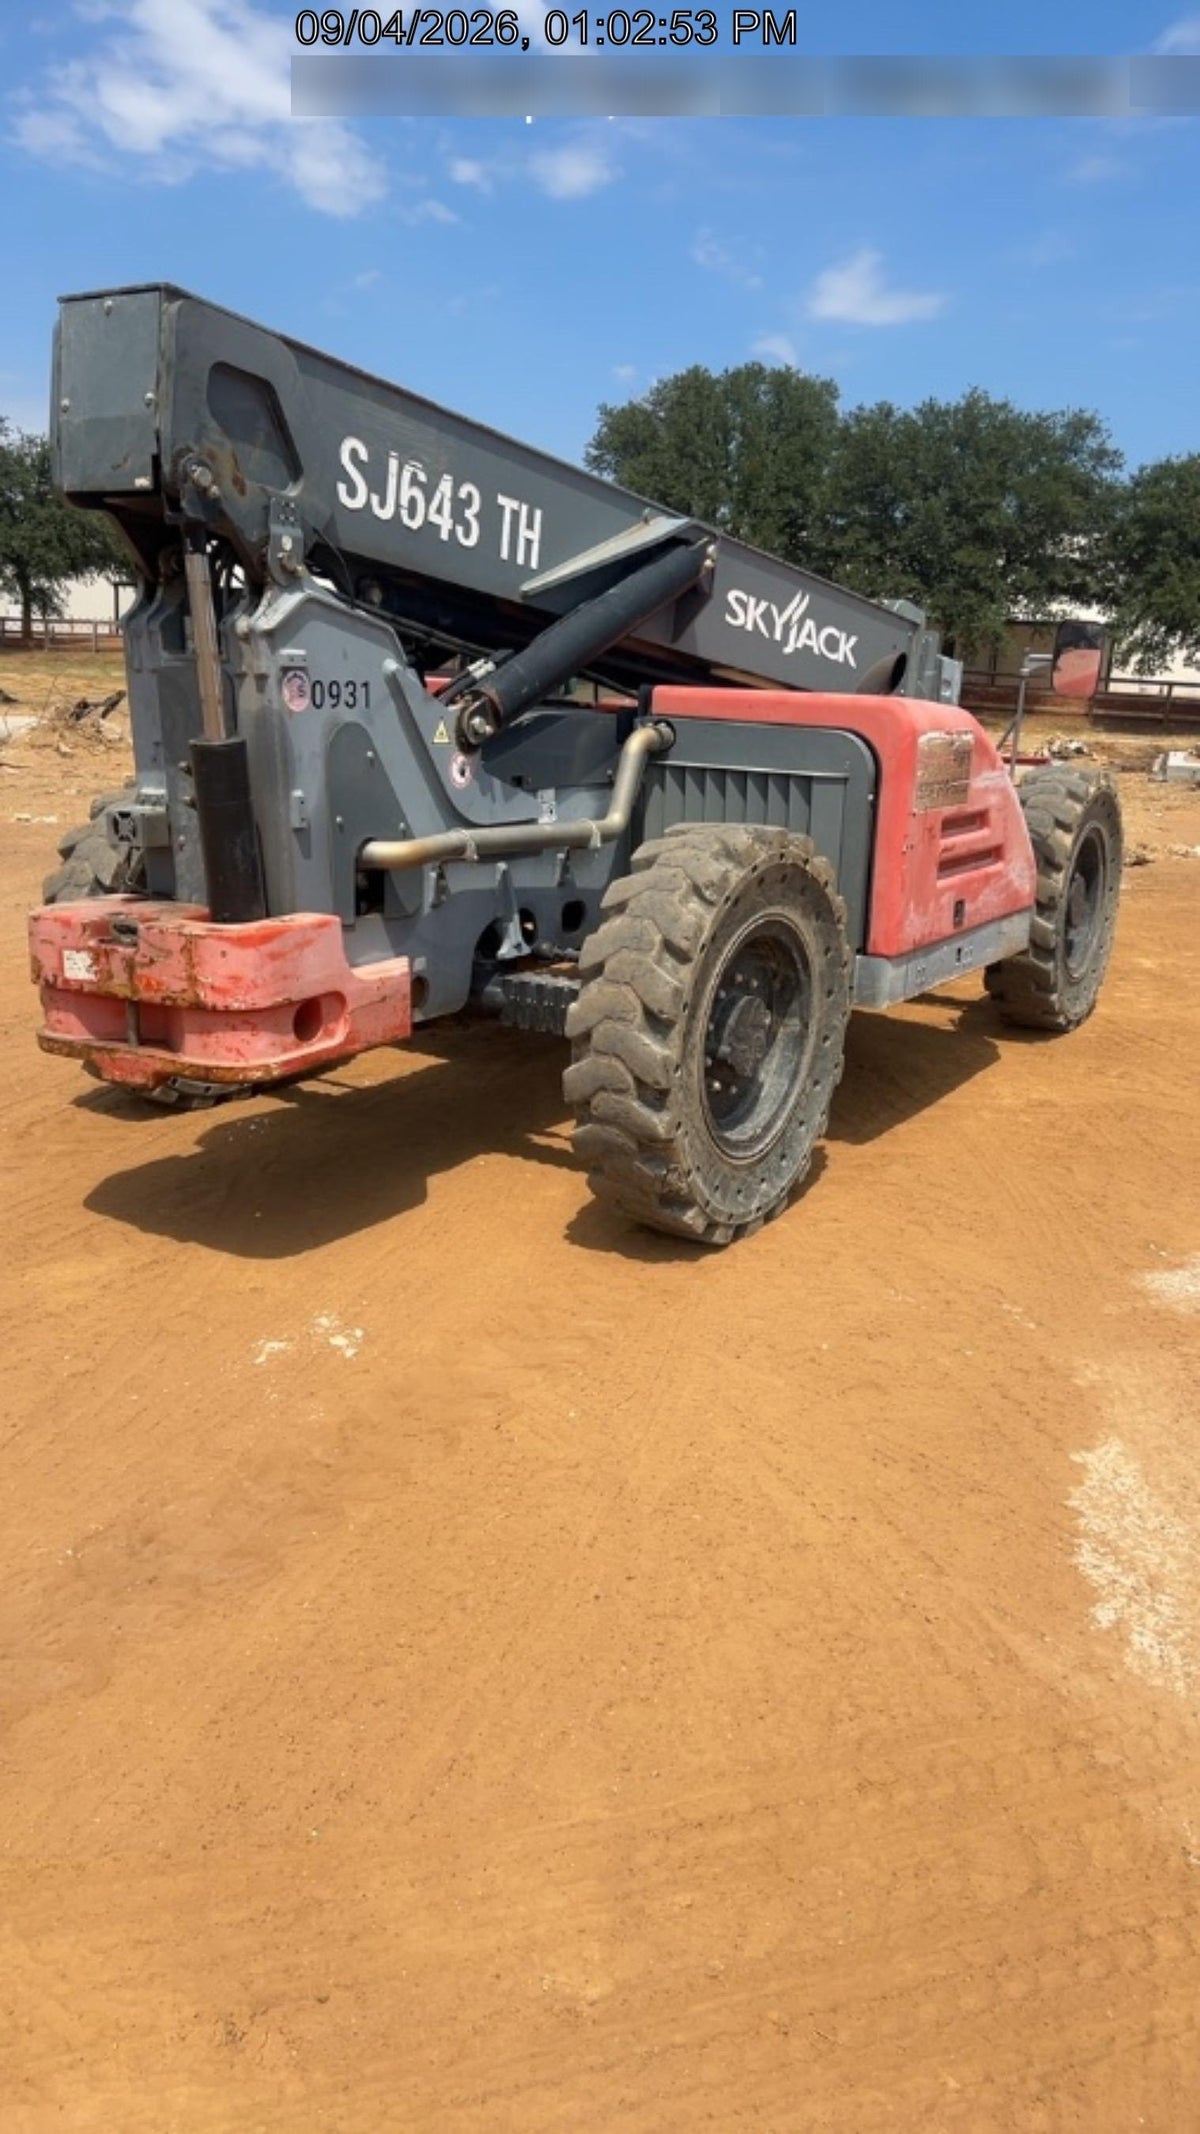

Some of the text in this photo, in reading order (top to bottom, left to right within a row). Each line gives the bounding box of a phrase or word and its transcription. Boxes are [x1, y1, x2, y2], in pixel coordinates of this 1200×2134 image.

[336, 435, 543, 570] SJ643 TH
[725, 589, 859, 669] SKYJACK
[311, 680, 370, 709] 0931
